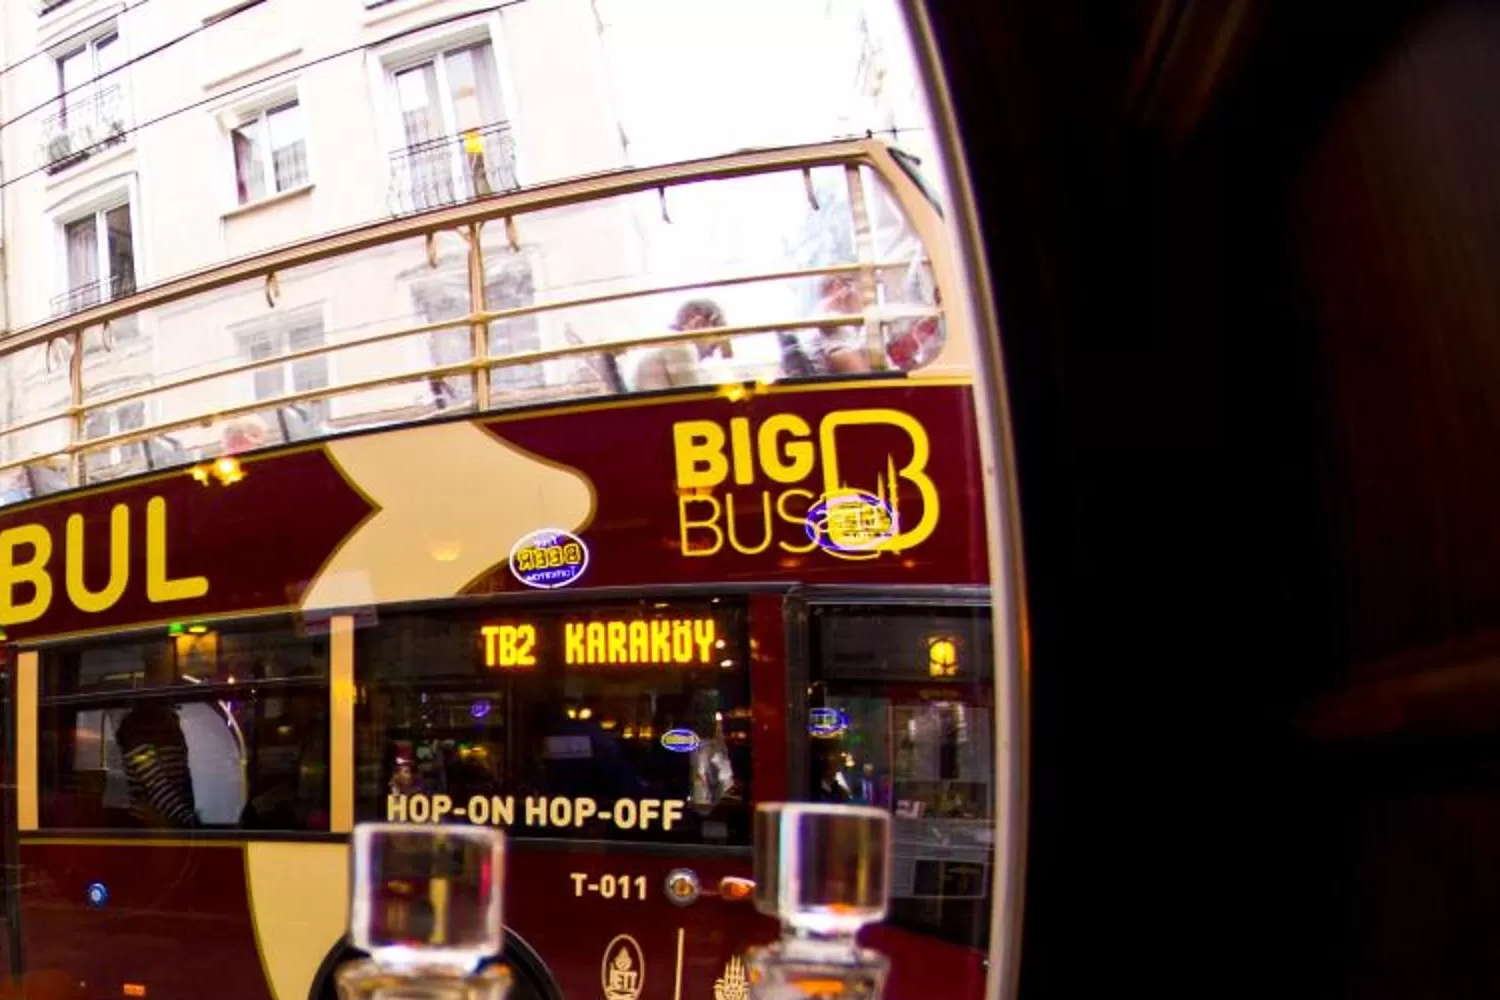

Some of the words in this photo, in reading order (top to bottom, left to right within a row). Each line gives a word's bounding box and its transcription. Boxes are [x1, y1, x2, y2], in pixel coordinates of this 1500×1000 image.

[673, 413, 815, 489] BIG
[678, 489, 820, 557] BUS
[481, 624, 536, 667] TB2
[564, 619, 715, 664] KARAKÖY
[387, 794, 514, 825] HOP-ON
[524, 796, 684, 831] HOP-OFF
[570, 872, 647, 900] T-011
